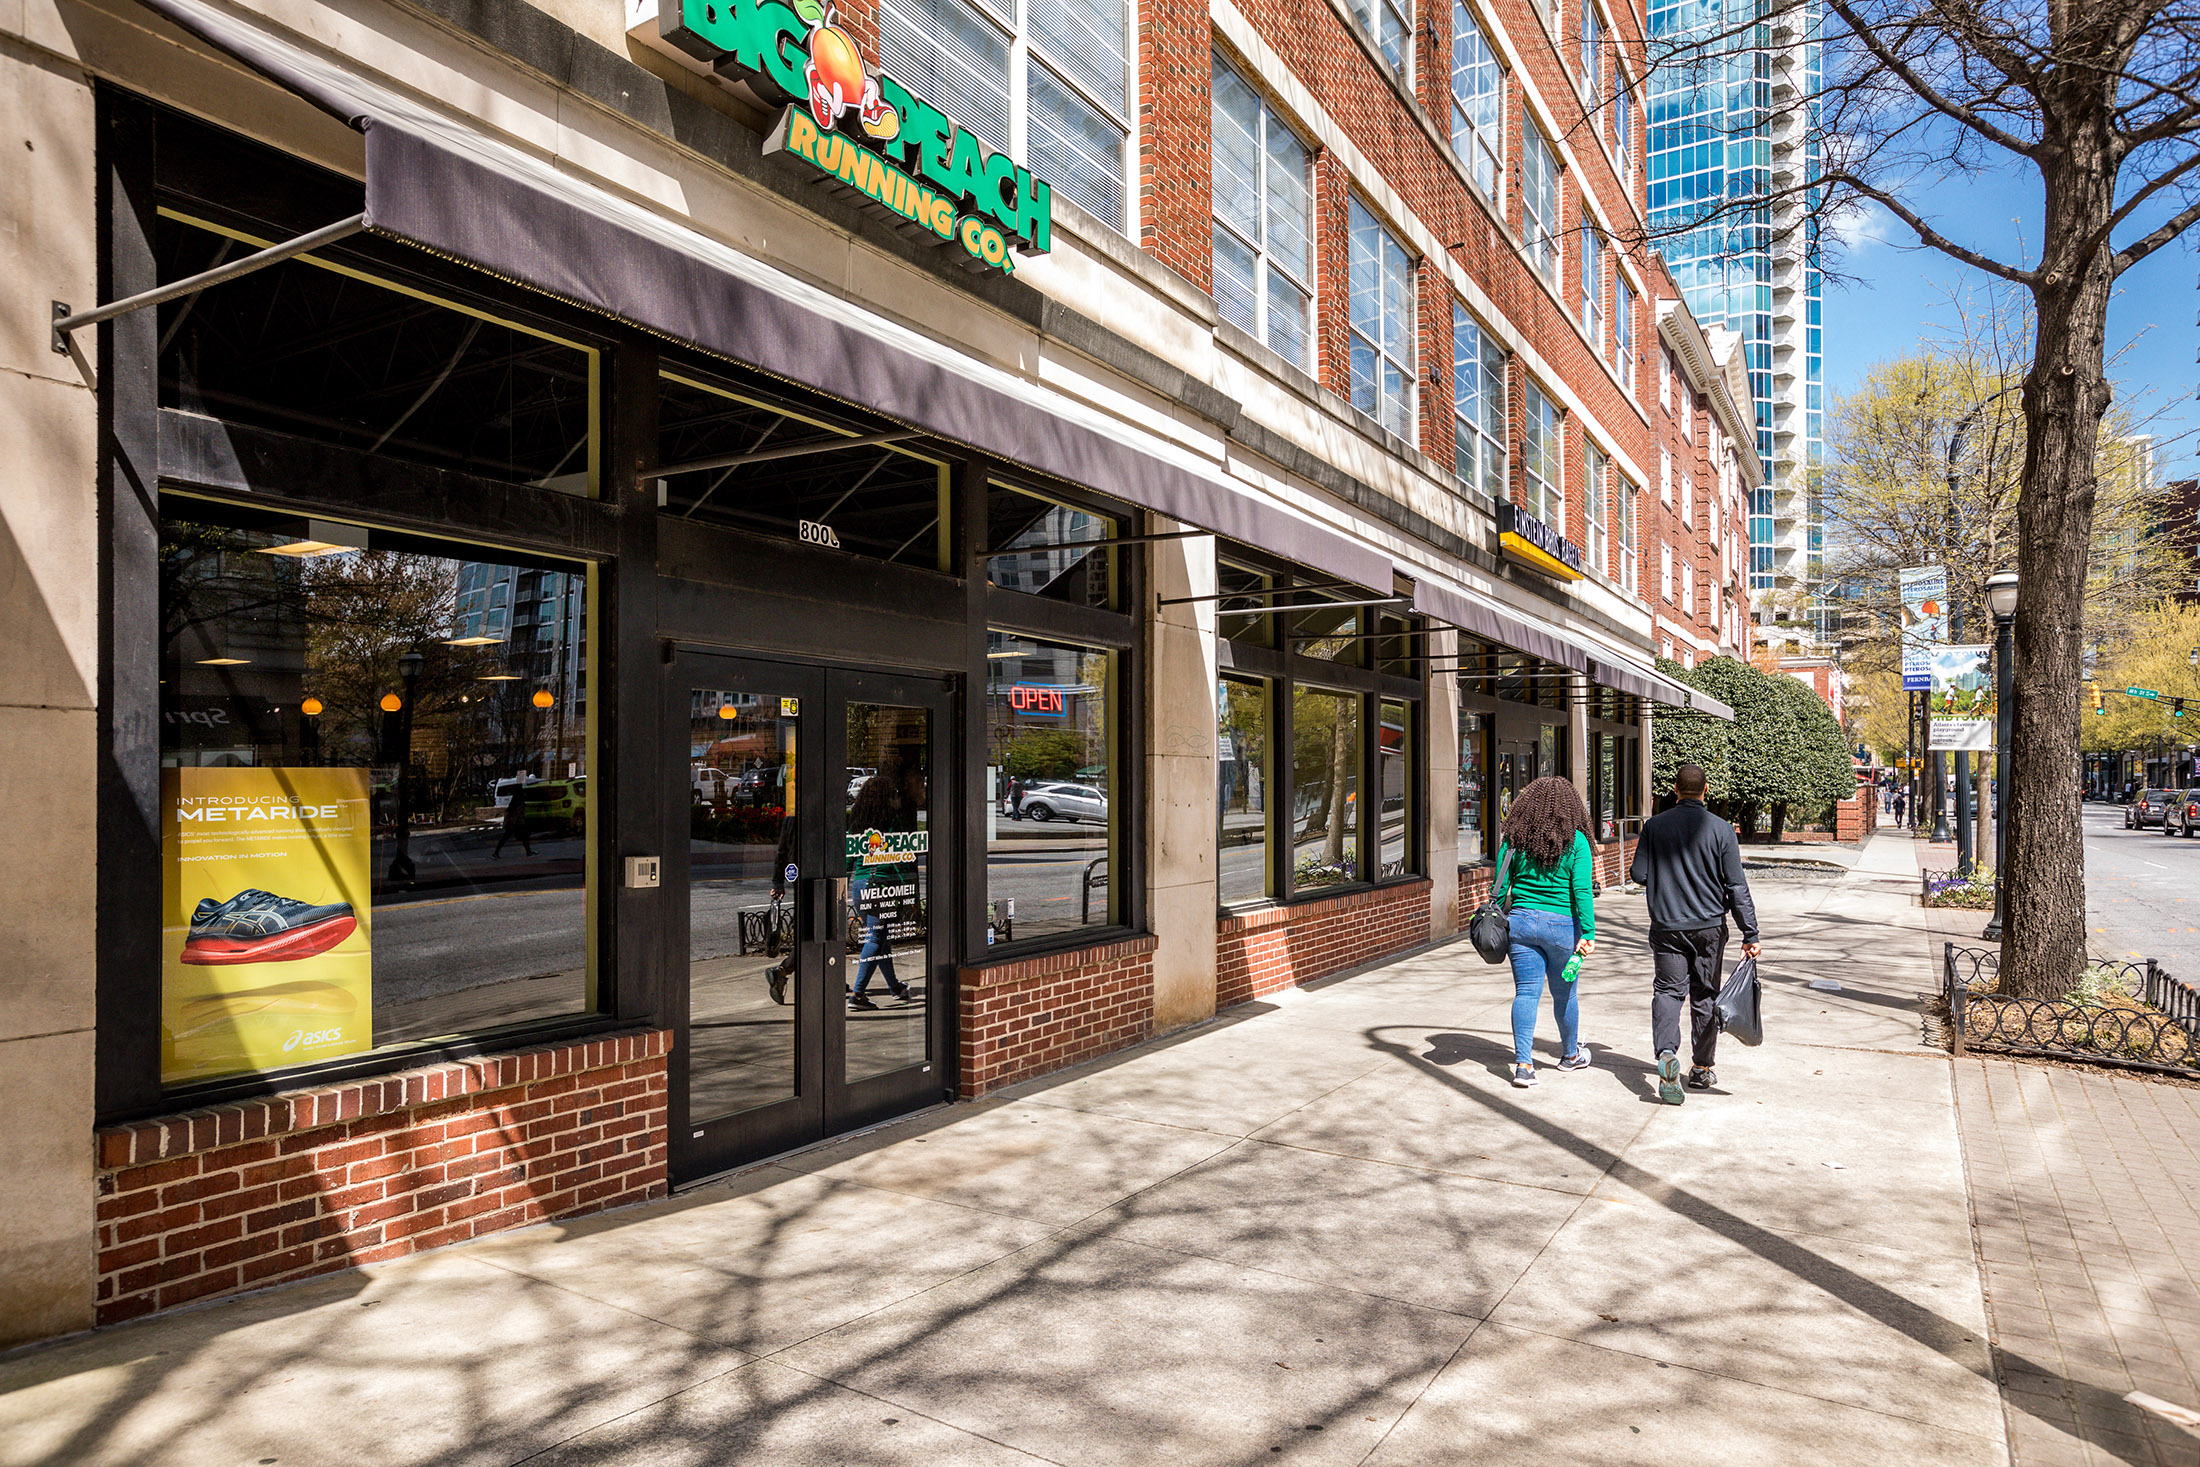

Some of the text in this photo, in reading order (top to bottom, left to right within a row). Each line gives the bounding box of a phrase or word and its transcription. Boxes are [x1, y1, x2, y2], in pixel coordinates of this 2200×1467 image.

[684, 0, 1051, 254] BIG PEACH
[788, 110, 1013, 272] RUNNING CO.
[1011, 686, 1062, 712] OPEN
[177, 795, 300, 806] INTRODUCING
[177, 805, 338, 823] METARIDE
[846, 833, 928, 854] BIG PEACH
[177, 854, 237, 862] INNOVATION
[250, 851, 287, 859] MOTION
[865, 852, 915, 864] RUNNING CO.
[860, 884, 915, 900] WELCOME!!
[860, 903, 872, 911] RUN
[879, 900, 896, 908] WALK
[879, 911, 897, 919] HOURS
